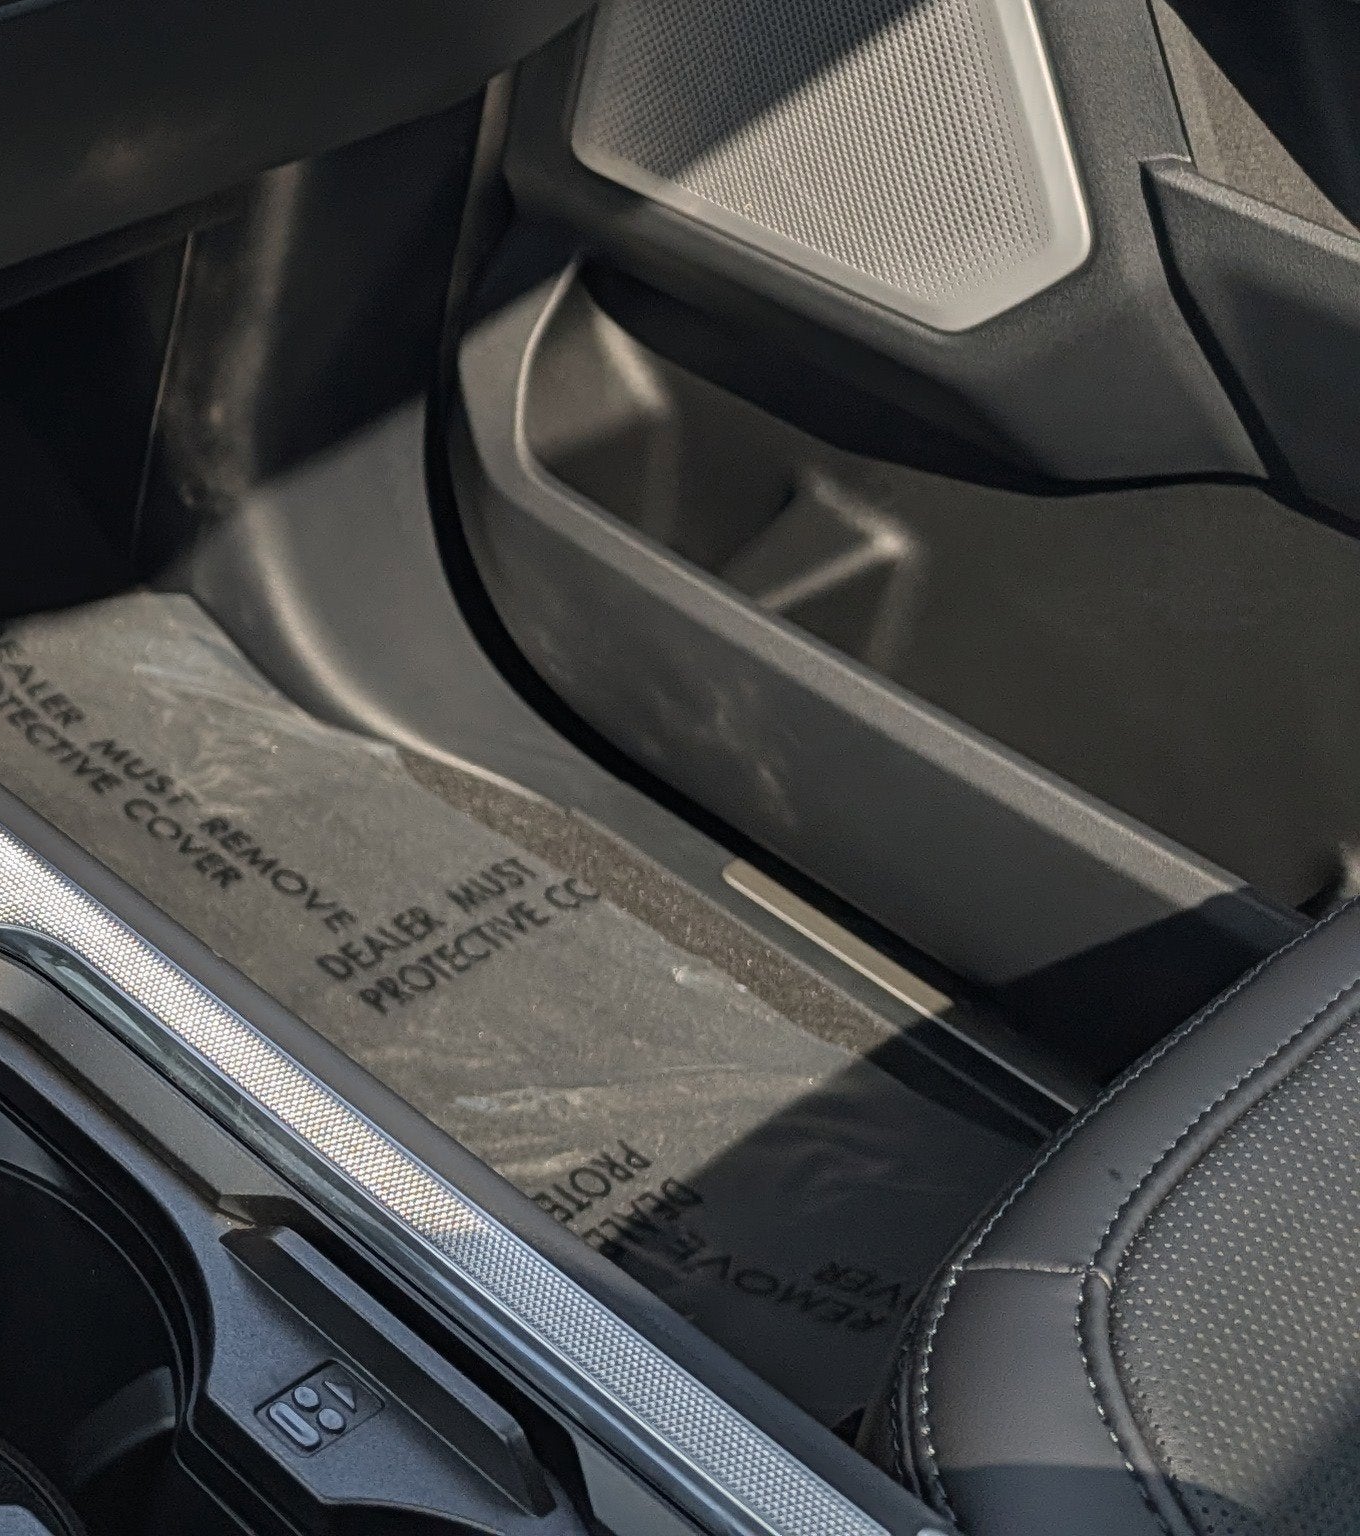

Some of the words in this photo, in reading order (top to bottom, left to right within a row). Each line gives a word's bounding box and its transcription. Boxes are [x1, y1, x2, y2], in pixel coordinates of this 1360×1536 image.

[91, 738, 201, 809] MUST
[200, 817, 357, 934] REMOVE
[123, 797, 245, 890] COVER
[316, 906, 445, 982] DEALER
[445, 856, 537, 913] MUST
[358, 900, 551, 1015] PROTECTIVE
